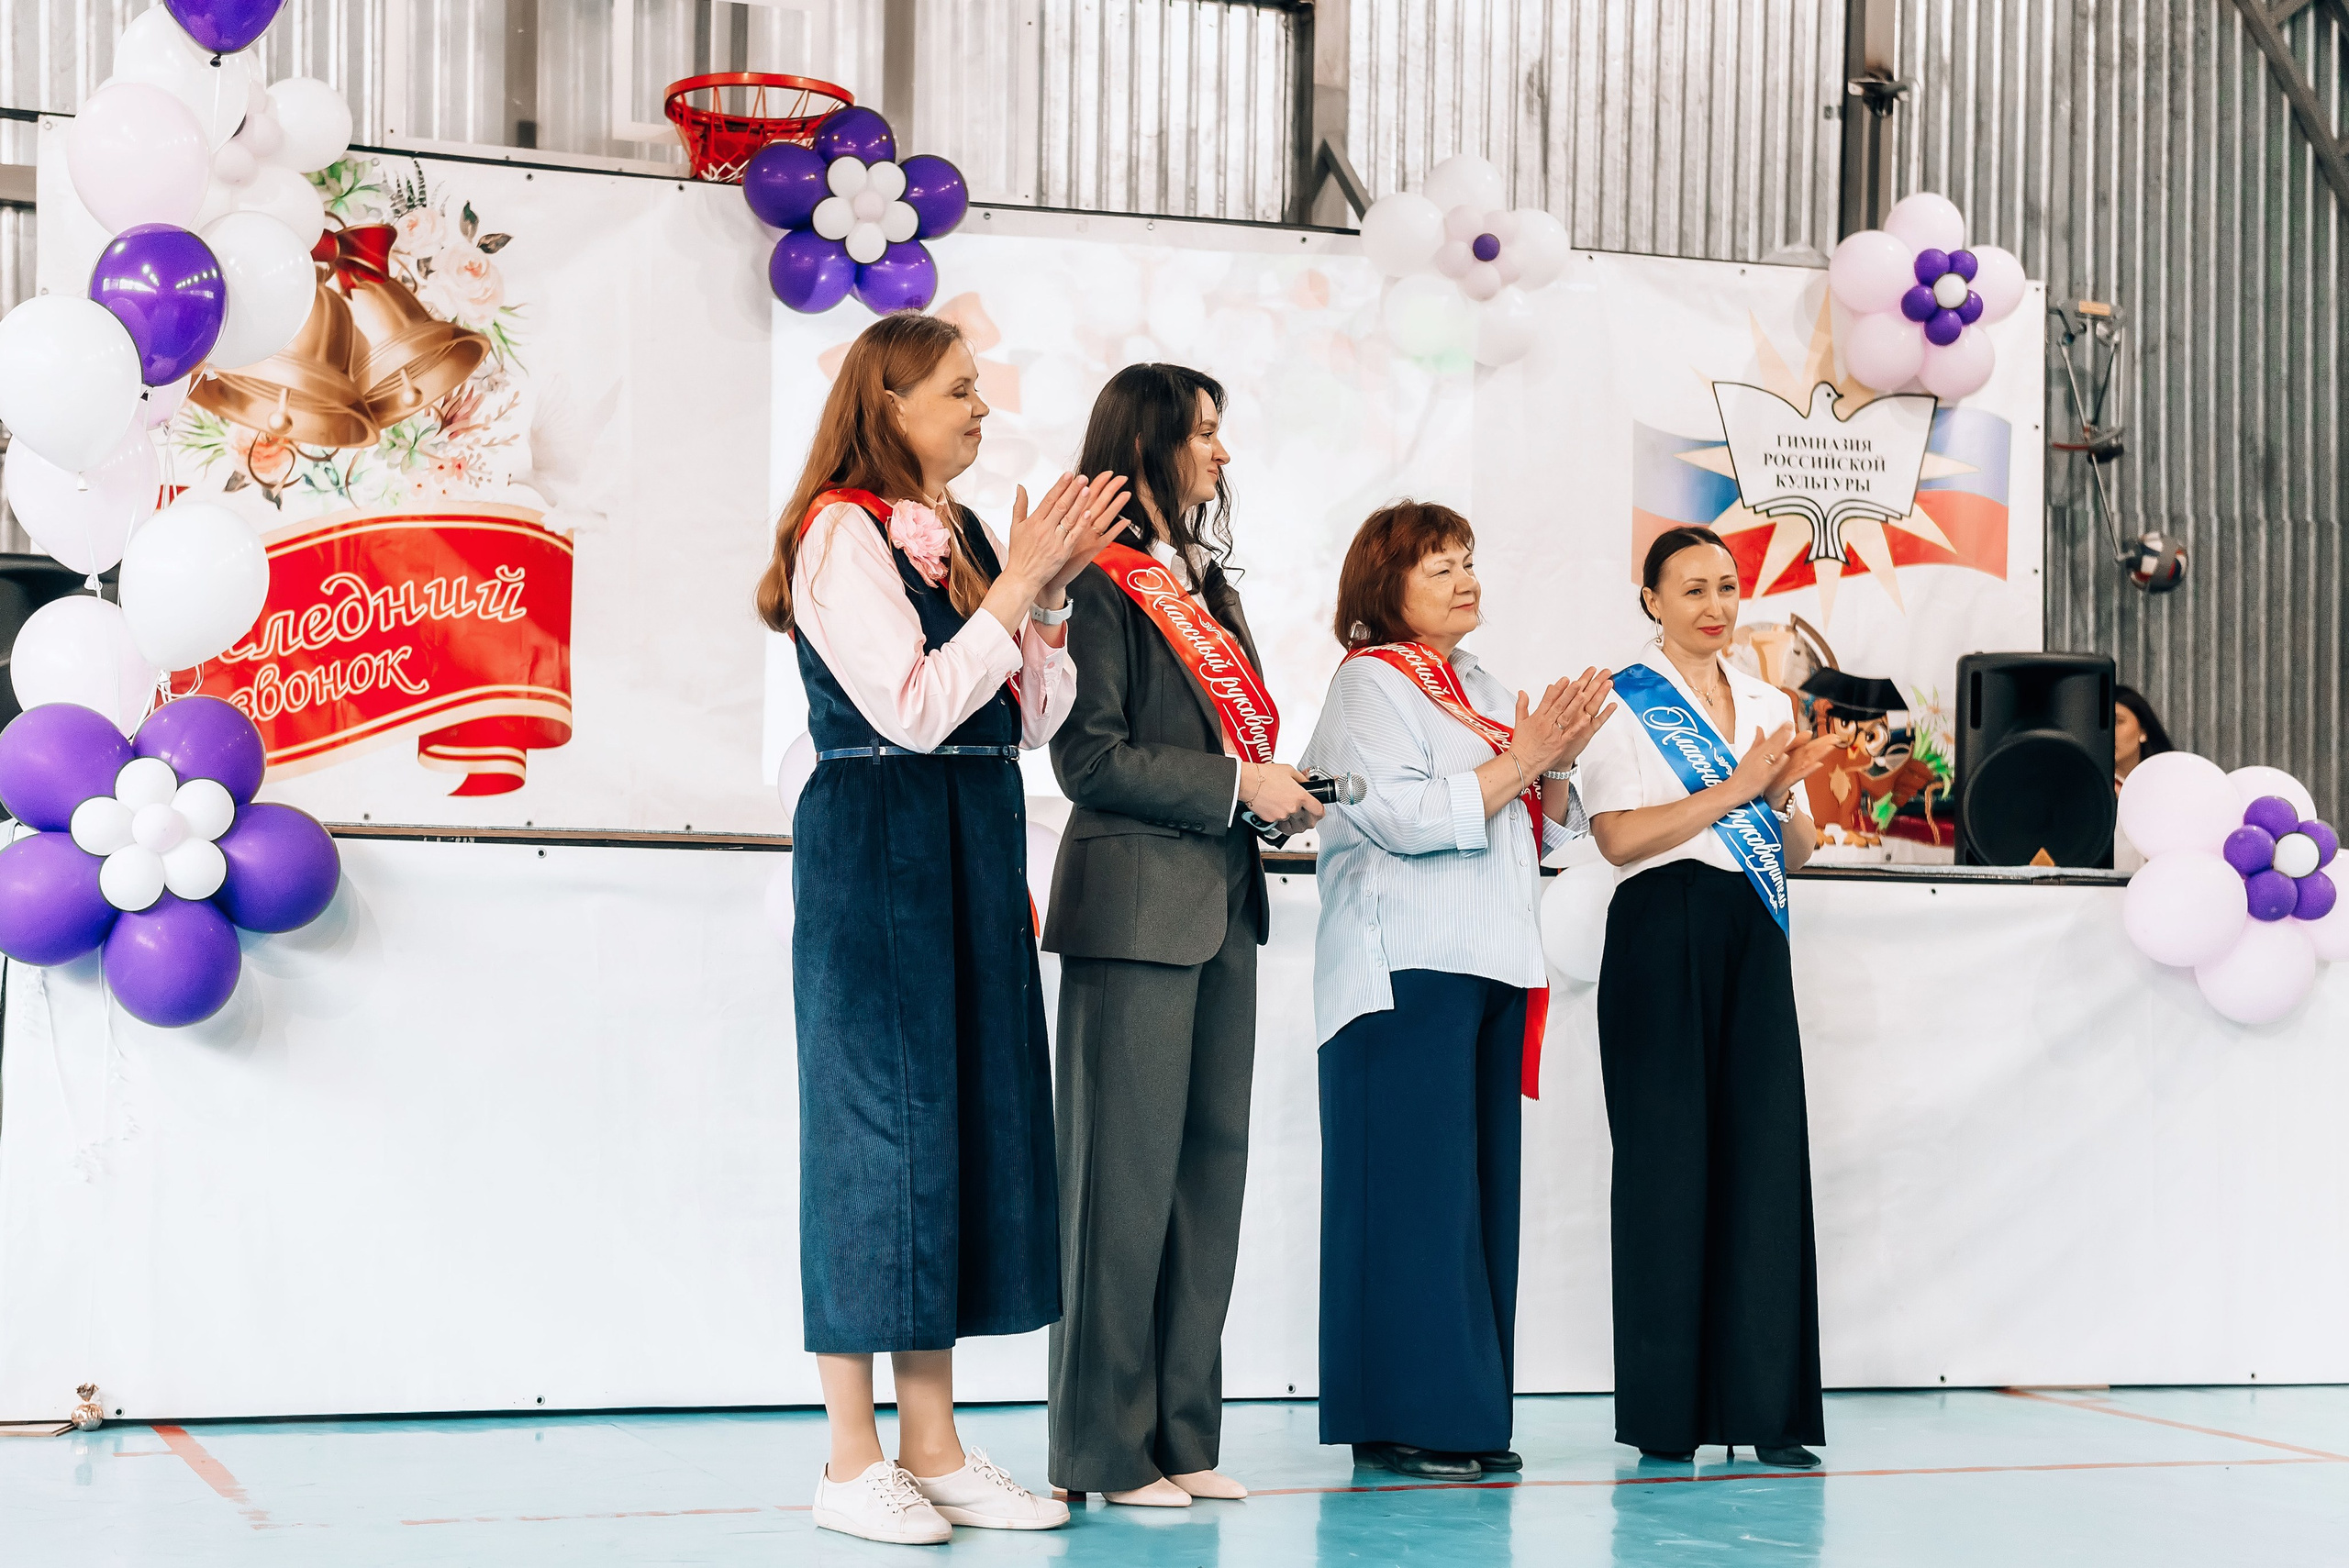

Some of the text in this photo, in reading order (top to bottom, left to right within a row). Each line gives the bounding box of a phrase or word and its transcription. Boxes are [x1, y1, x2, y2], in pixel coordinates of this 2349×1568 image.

[1776, 434, 1872, 451] ГИМНАЗИЯ
[1764, 452, 1886, 473] РОССИЙСКОЙ
[1776, 473, 1871, 493] КУЛЬТУРЫ
[1127, 566, 1275, 764] Классный руководит
[227, 645, 429, 722] звонок
